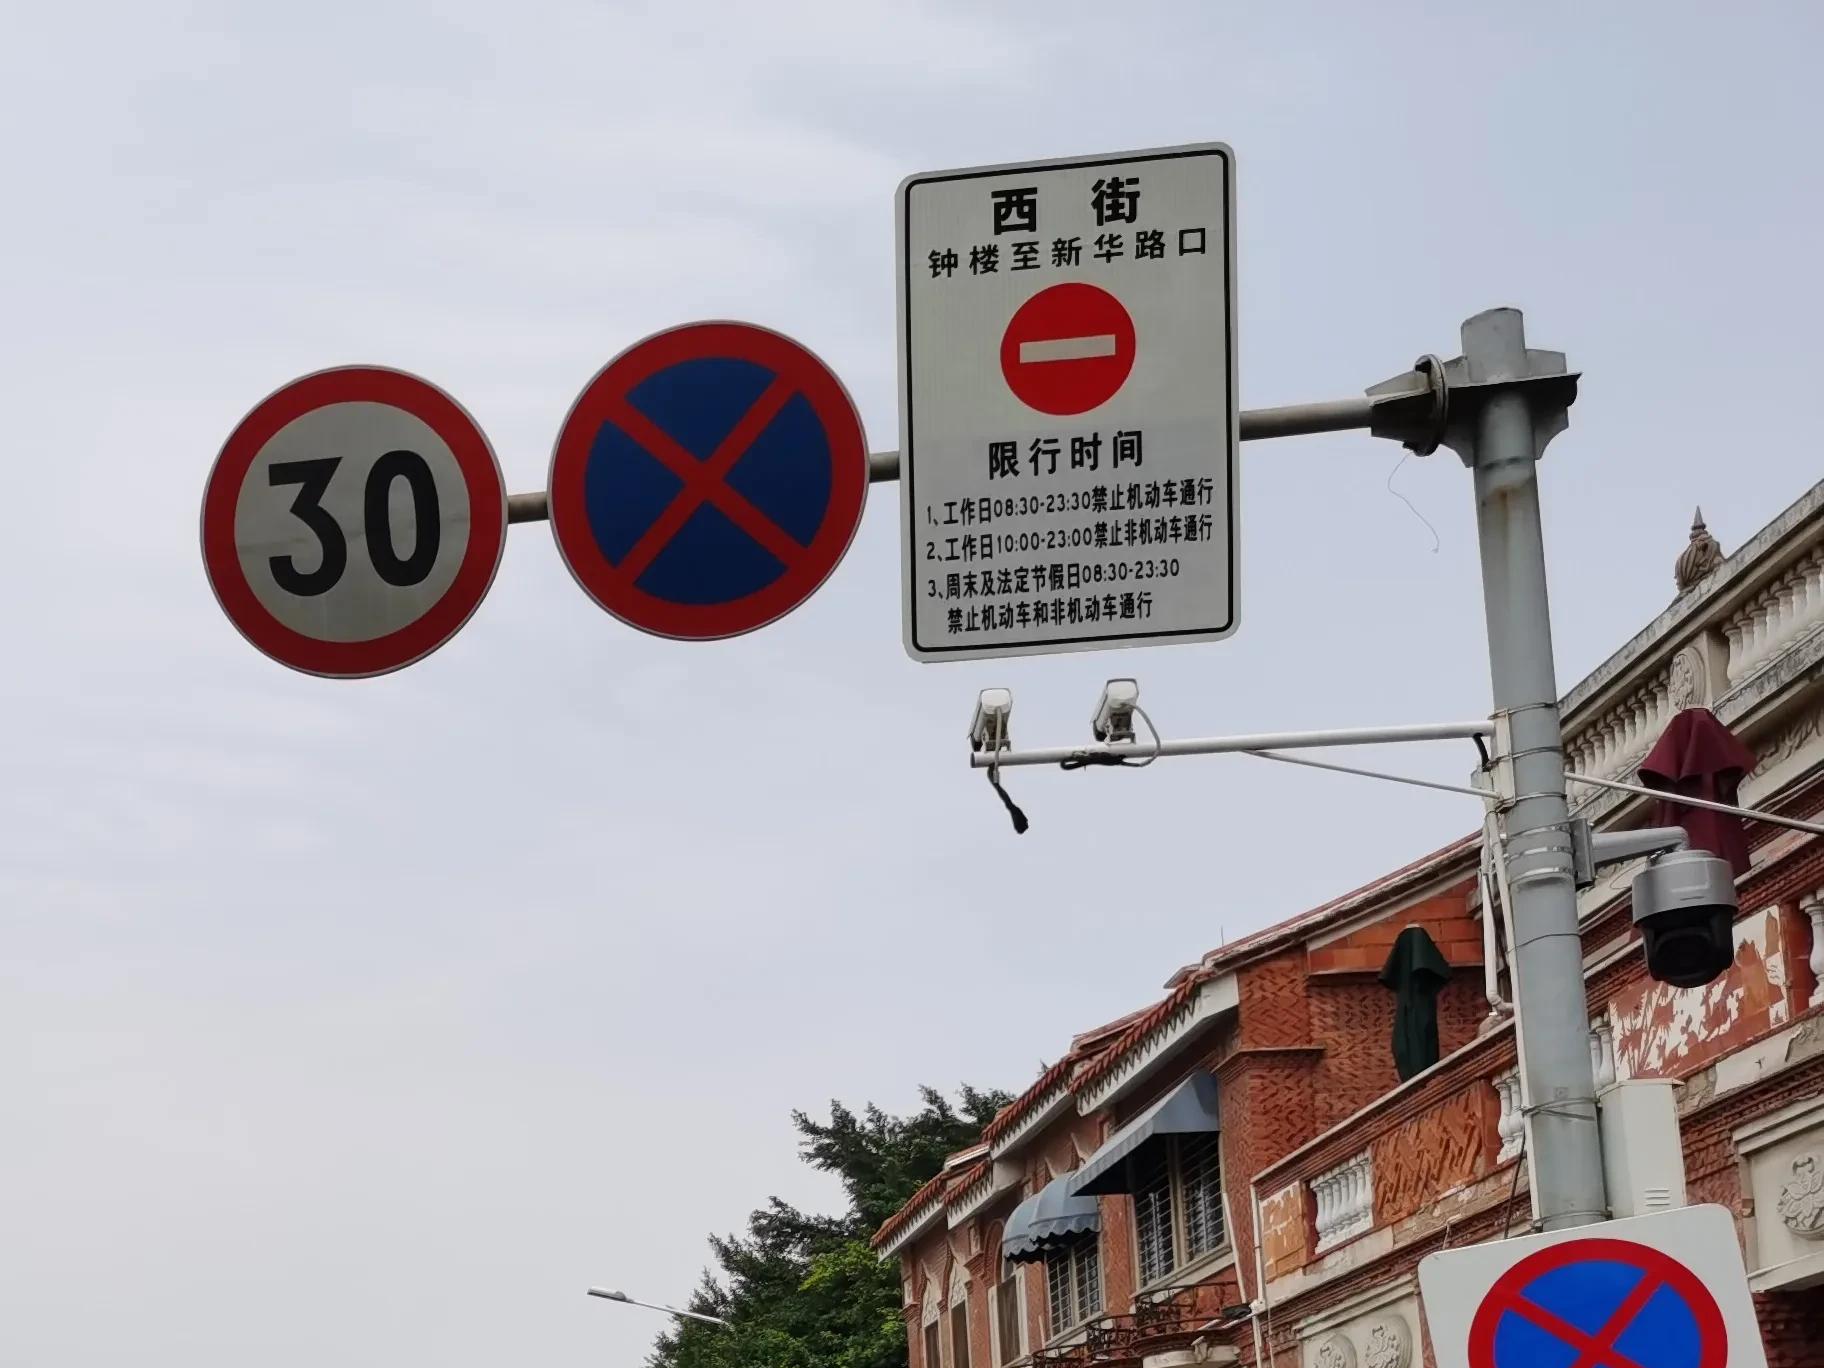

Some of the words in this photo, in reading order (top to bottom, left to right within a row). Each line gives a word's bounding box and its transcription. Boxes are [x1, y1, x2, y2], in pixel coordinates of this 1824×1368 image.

[991, 176, 1141, 236] 西街
[927, 227, 1207, 279] 钟楼至新华路口
[987, 430, 1144, 480] 限行时间
[268, 449, 441, 597] 30
[947, 591, 1154, 635] 禁止机动车和非机动车通行
